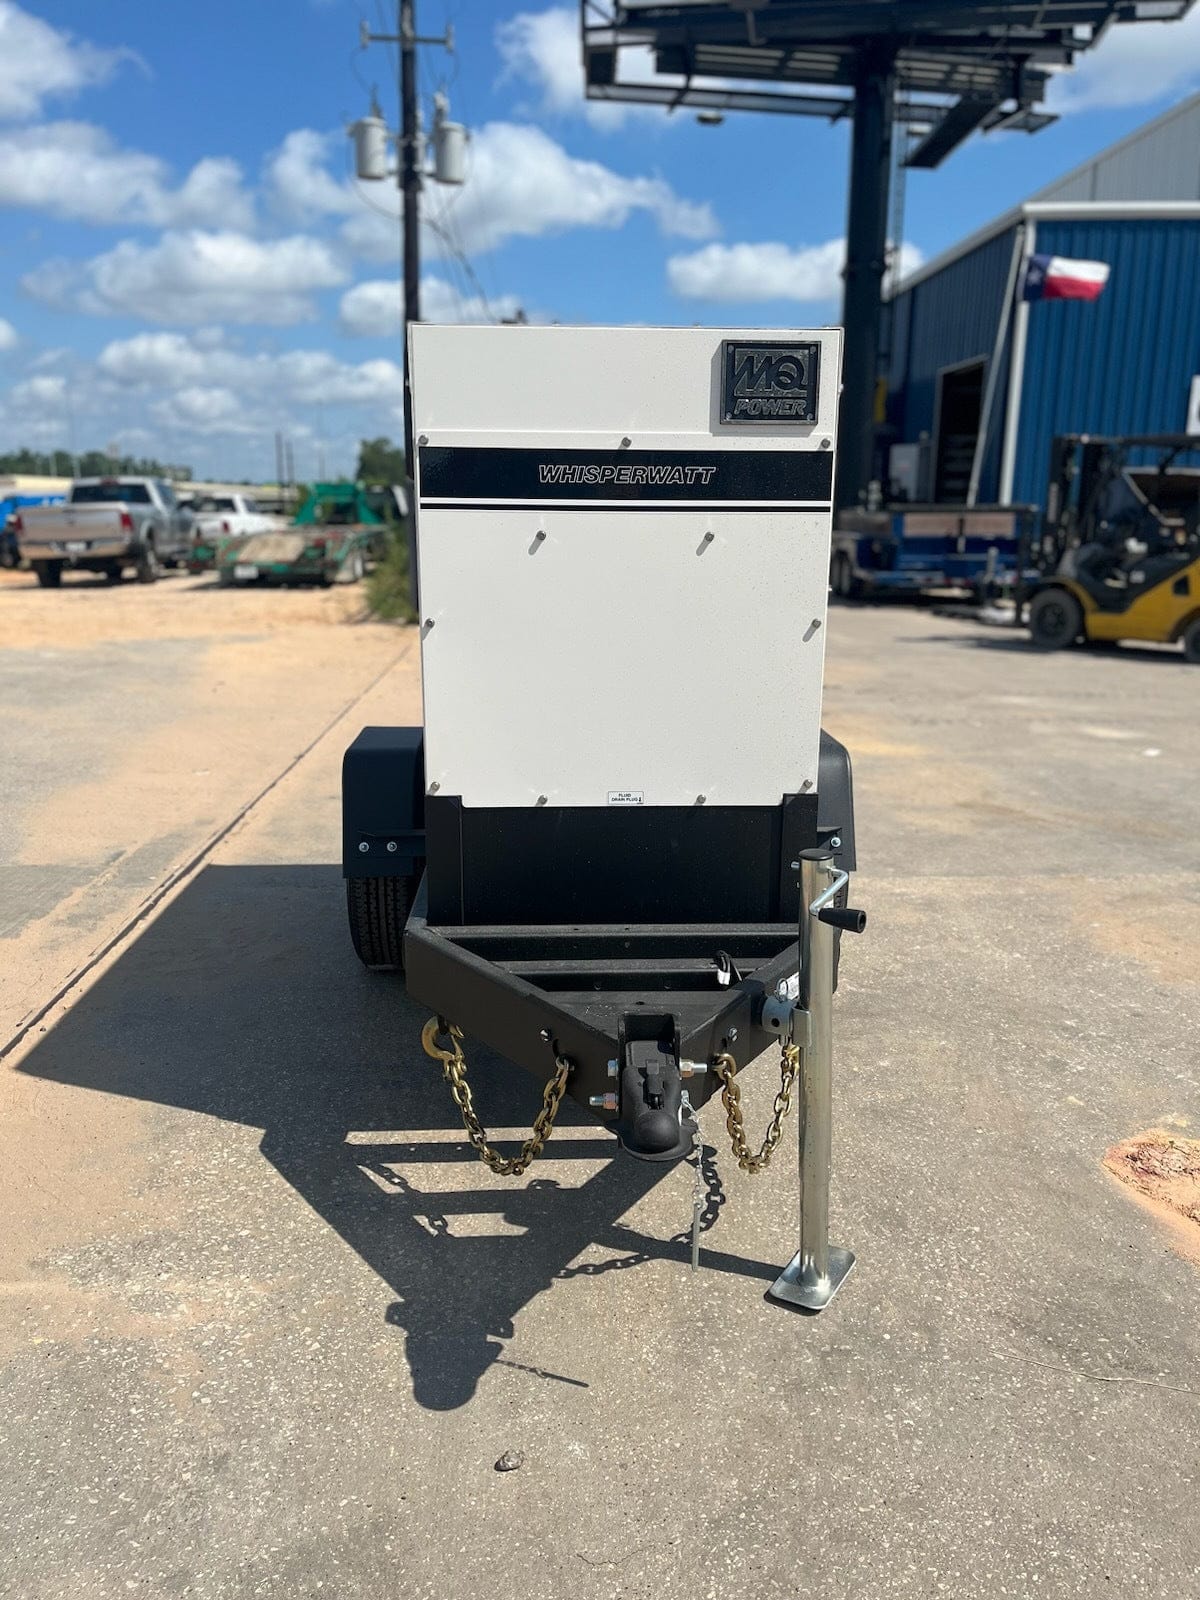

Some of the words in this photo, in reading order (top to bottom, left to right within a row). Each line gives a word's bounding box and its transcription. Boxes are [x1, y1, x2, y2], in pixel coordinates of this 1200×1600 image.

[734, 353, 807, 393] MQ
[734, 399, 807, 416] POWER
[538, 465, 716, 484] WHISPERWATT
